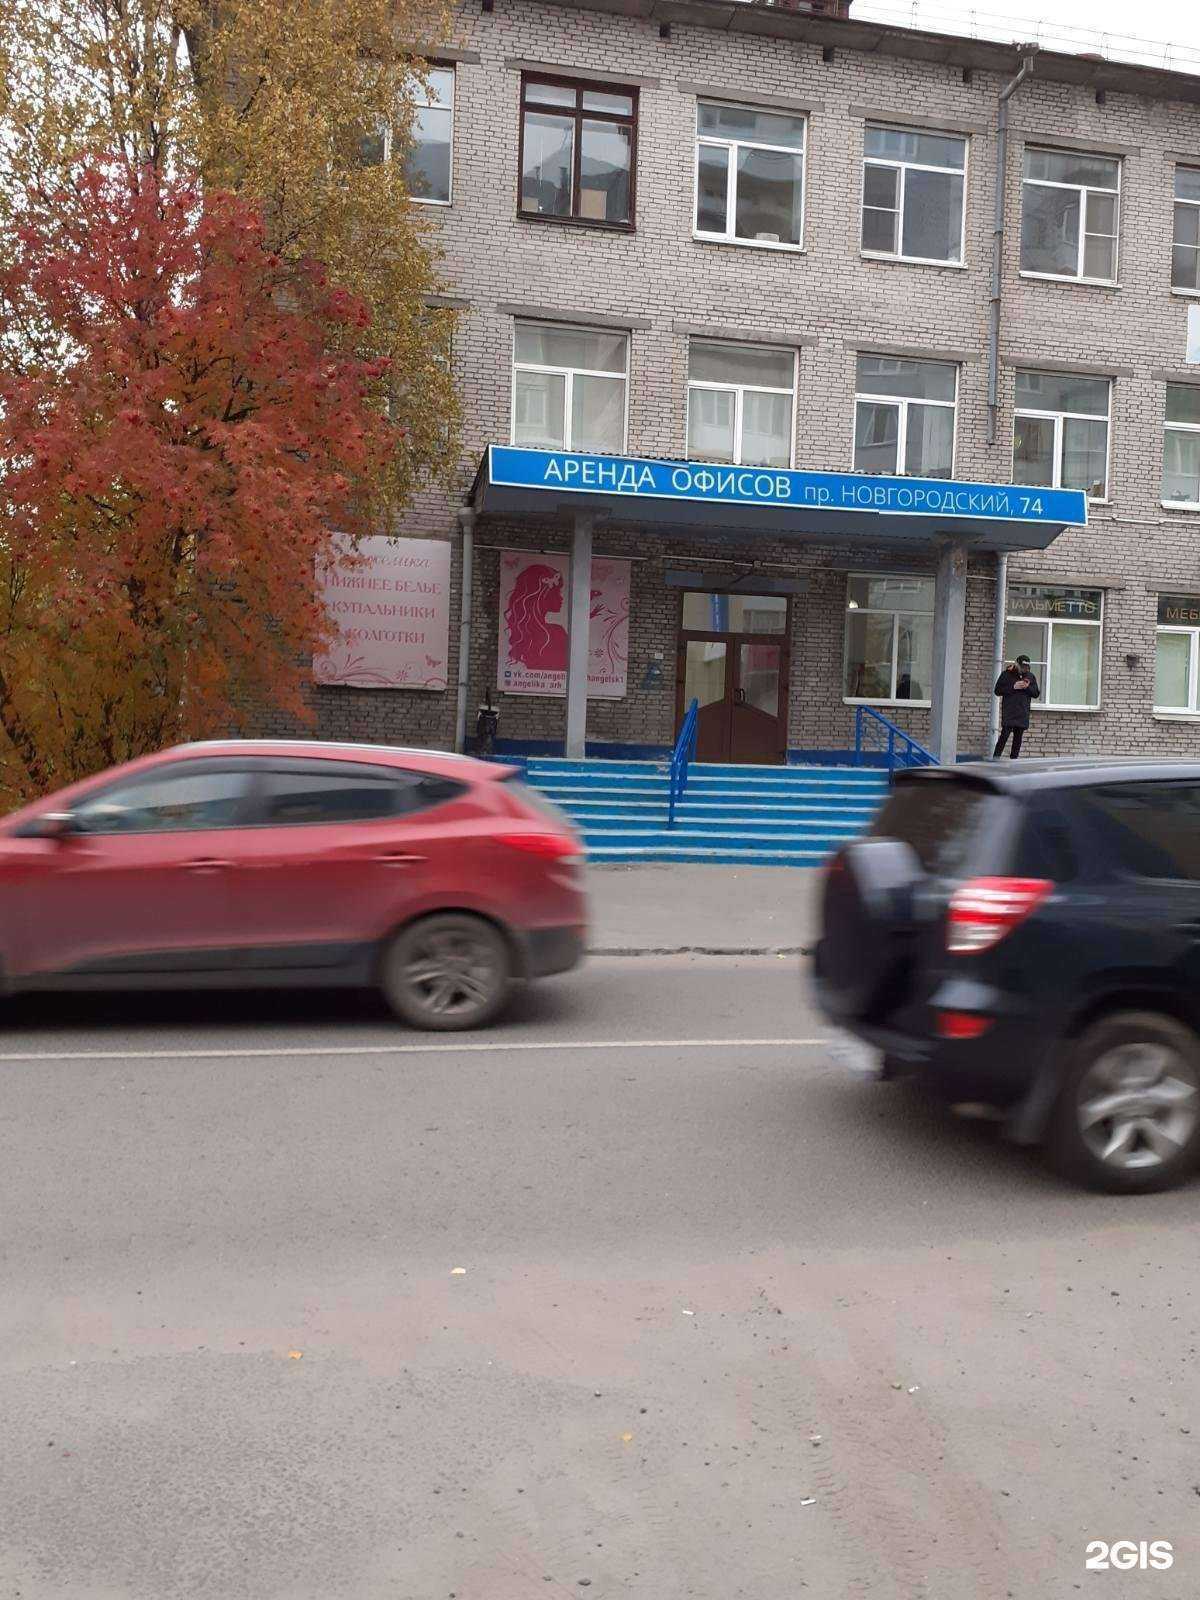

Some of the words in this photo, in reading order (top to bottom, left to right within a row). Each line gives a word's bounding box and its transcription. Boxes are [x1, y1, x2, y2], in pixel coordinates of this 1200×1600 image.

[544, 459, 656, 492] АРЕНДА
[672, 468, 791, 498] ОФИСОВ
[805, 486, 834, 506] пр.
[842, 484, 1013, 515] НОВГОРОДСКИЙ,
[1020, 497, 1043, 515] 74
[332, 601, 435, 619] КУПАЛЬНИКИ
[1166, 607, 1200, 620] МЕБ
